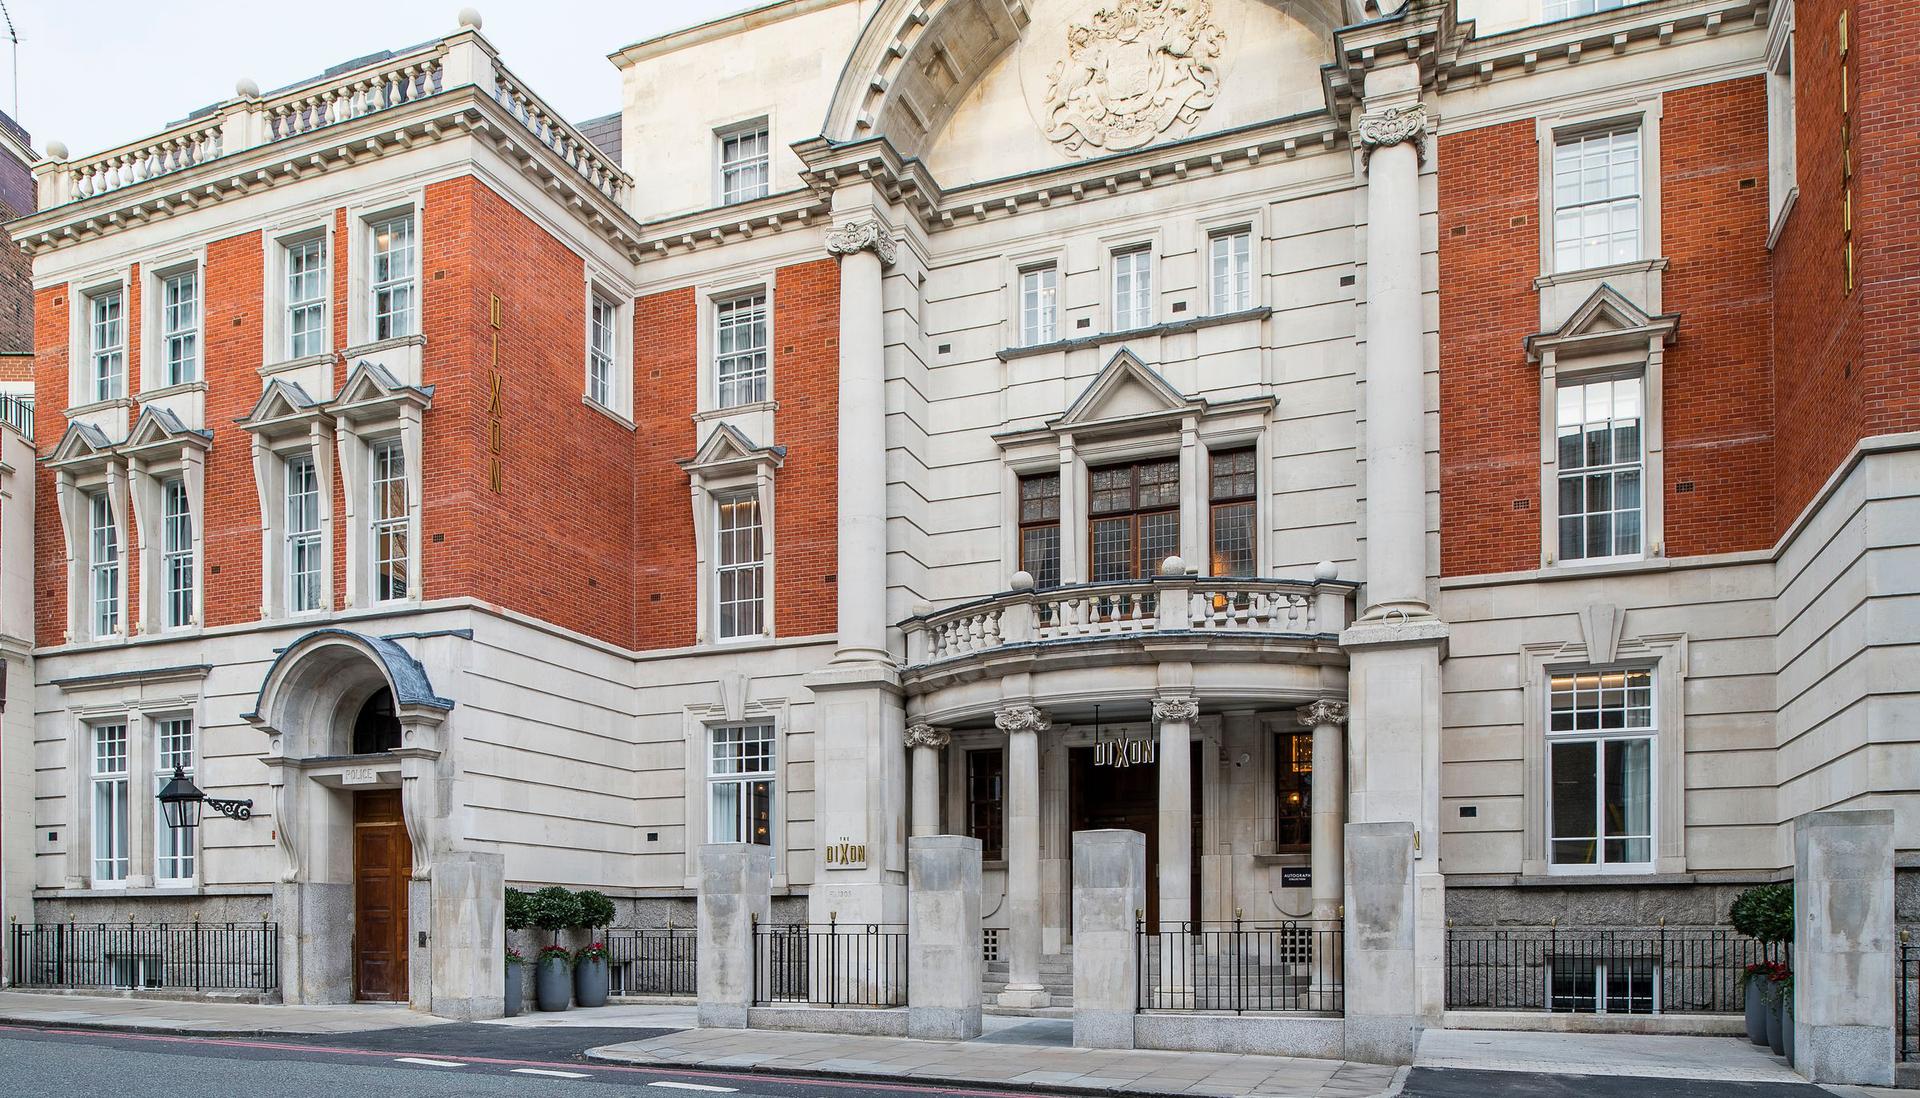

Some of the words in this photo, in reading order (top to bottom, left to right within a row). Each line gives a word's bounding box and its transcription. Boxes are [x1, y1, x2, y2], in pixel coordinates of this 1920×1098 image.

[488, 292, 502, 494] DIXON
[1094, 738, 1154, 767] DIXON
[345, 768, 373, 780] POLICE
[827, 844, 865, 865] DIXON
